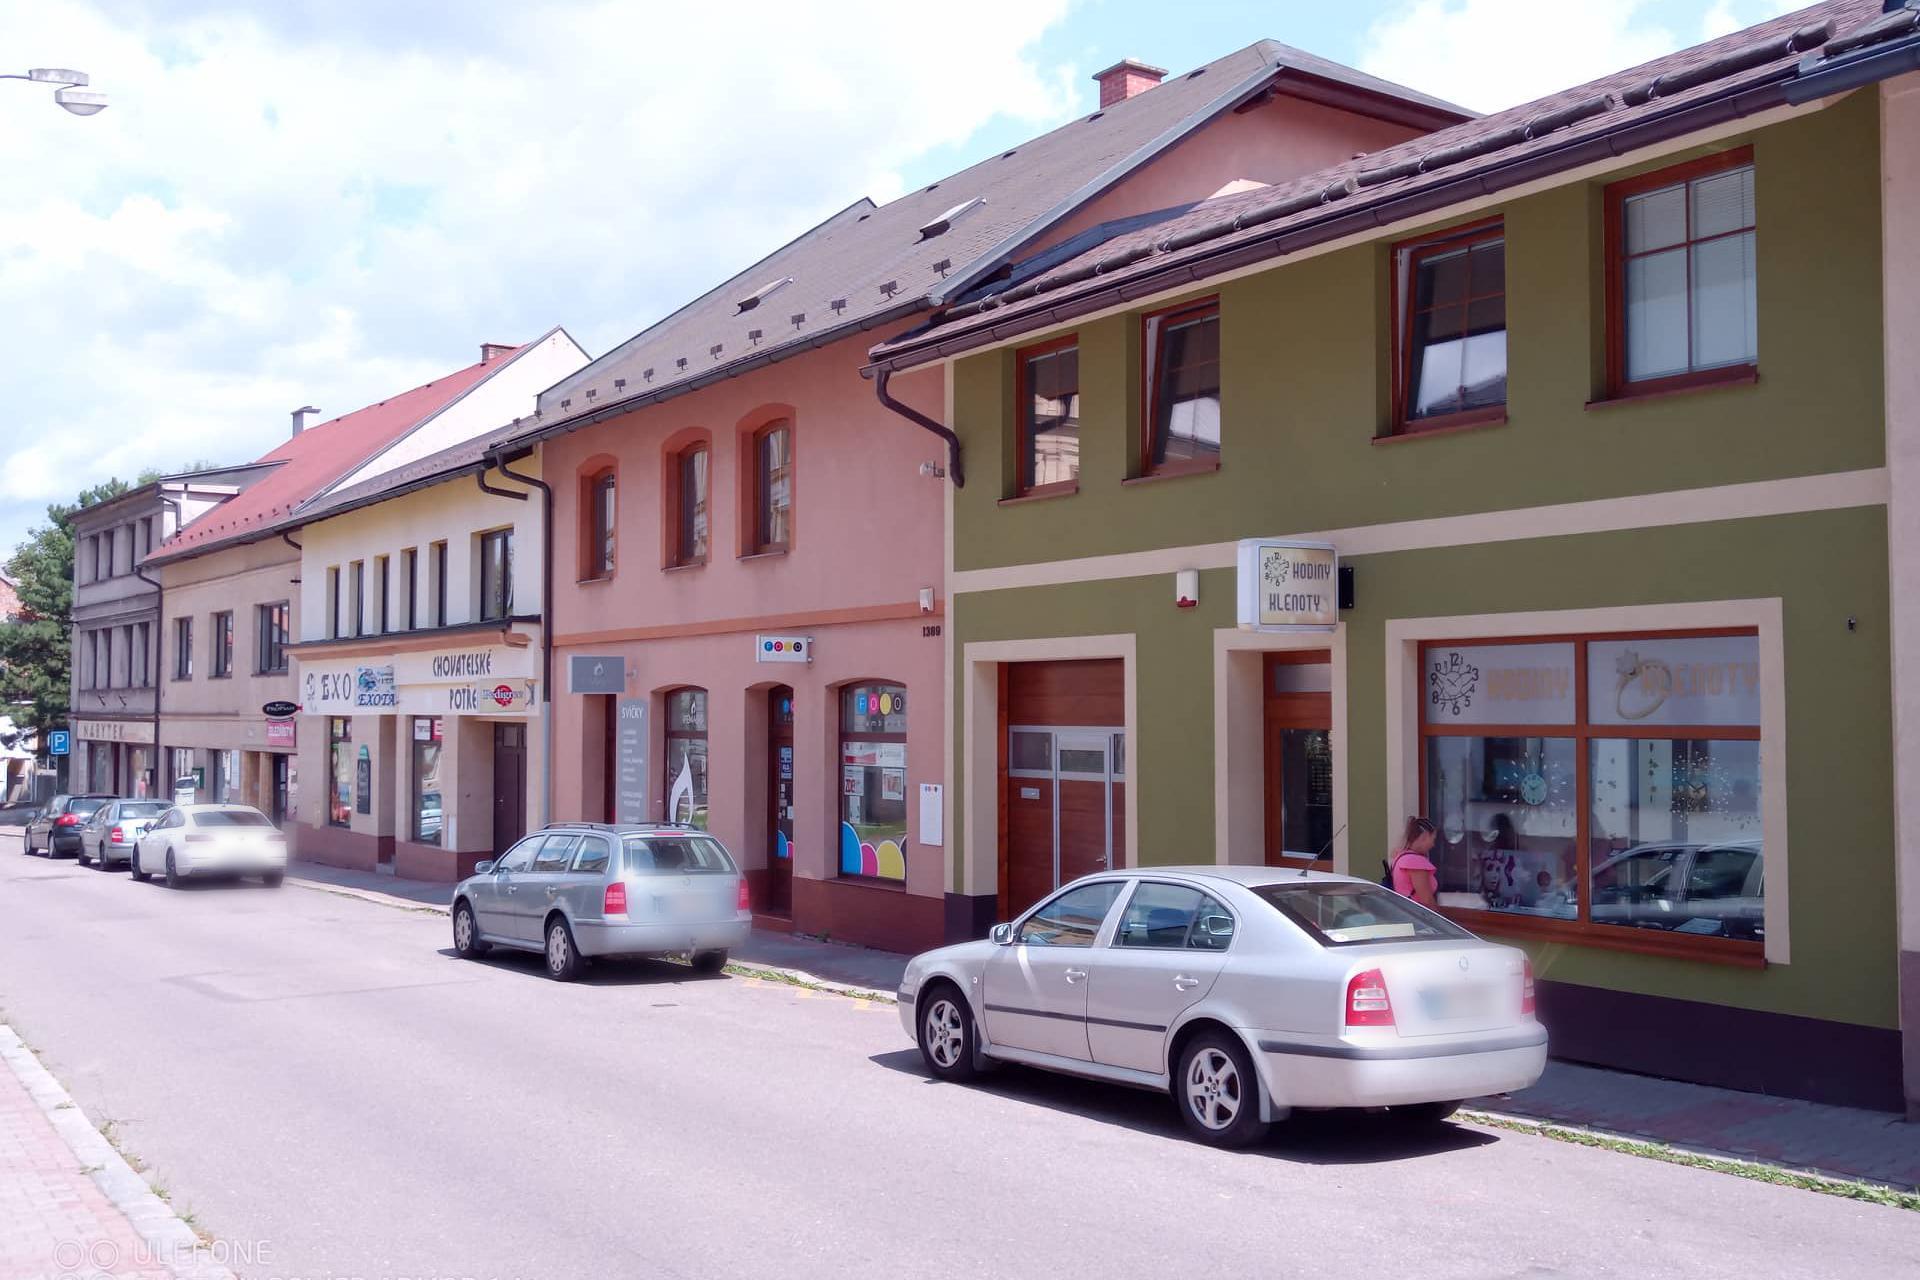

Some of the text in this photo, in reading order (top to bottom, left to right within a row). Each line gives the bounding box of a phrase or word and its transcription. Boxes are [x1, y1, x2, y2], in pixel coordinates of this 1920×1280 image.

[1292, 562, 1331, 580] HODINY
[1269, 593, 1320, 612] KLENOTY
[764, 641, 803, 652] FOO
[433, 649, 492, 677] CHOVATELSKÉ
[55, 735, 65, 747] P
